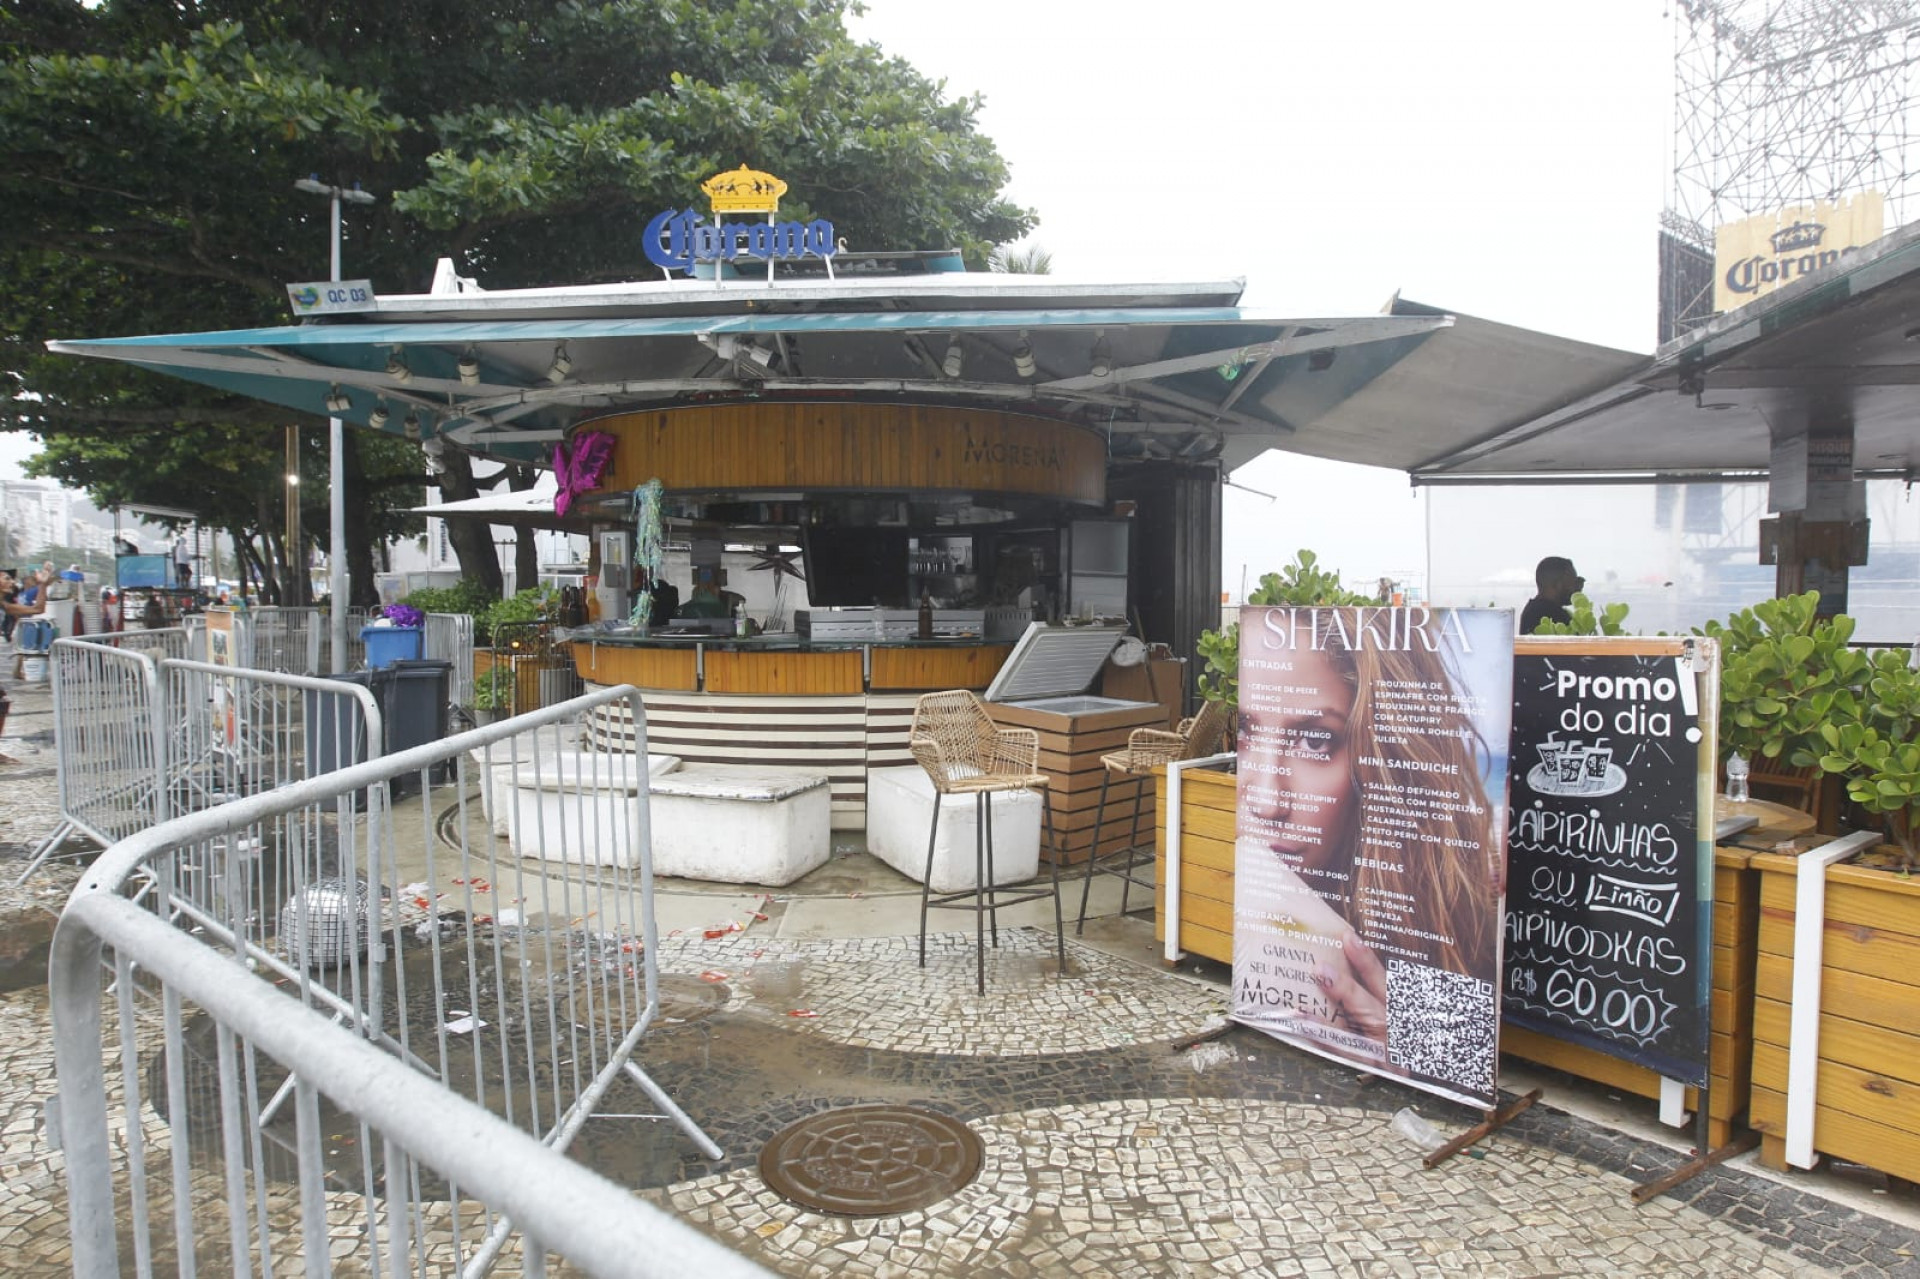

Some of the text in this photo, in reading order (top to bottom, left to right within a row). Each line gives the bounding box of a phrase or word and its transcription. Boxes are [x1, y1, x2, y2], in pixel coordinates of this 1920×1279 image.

[642, 207, 837, 276] Corona
[1726, 246, 1858, 294] Coron
[350, 288, 366, 302] 03
[963, 434, 1061, 470] MORENA
[1264, 607, 1472, 653] SHAKIRA
[1242, 659, 1293, 671] ENTRADAS
[1283, 685, 1294, 693] DE
[1376, 680, 1442, 690] TROUXINHA DE
[1558, 670, 1676, 702] Promo
[1375, 690, 1423, 700] ESPINAFRE
[1426, 693, 1447, 702] COM
[1283, 706, 1294, 715] DE
[1375, 702, 1427, 712] TROUXINHA
[1429, 704, 1442, 712] DE
[1374, 713, 1441, 725] COM CATUPIRY
[1560, 702, 1671, 737] do dia
[1300, 730, 1332, 740] FRANGO
[1374, 723, 1425, 735] TROUXINHA
[1373, 735, 1409, 745] JULIETA
[1296, 750, 1331, 761] TAPIOCA
[1358, 755, 1383, 767] MINI
[1241, 760, 1292, 776] SALGADOS
[1280, 790, 1297, 799] COM
[1298, 792, 1337, 804] CATUPIRY
[1368, 793, 1403, 804] FRANGO
[1405, 798, 1426, 807] COM
[1406, 786, 1460, 800] DEFUMADO
[1291, 802, 1320, 812] QUEIJO
[1367, 804, 1453, 822] AUSTRALIANO COM
[1284, 822, 1295, 830] DE
[1296, 824, 1323, 834] CARNE
[1367, 815, 1418, 829] CALABRESA
[1281, 832, 1322, 845] CROCANTE
[1366, 826, 1480, 850] PEITO PERU COM QUEIJO
[1366, 837, 1403, 850] BRANCO
[1302, 866, 1324, 876] ALHO
[1354, 856, 1404, 873] BEBIDAS
[1531, 866, 1575, 897] OU
[1363, 886, 1415, 902] CAIPIRINHA
[1363, 897, 1380, 907] GIN
[1363, 908, 1403, 922] CERVEJA
[1288, 930, 1343, 949] PRIVATIVO
[1364, 918, 1455, 948] (BRAHMA/ORIGINAL)
[1503, 910, 1686, 975] AIPIVODKAS
[1263, 943, 1316, 965] GARANTA
[1363, 940, 1429, 961] REFRIGERANTE
[1250, 960, 1334, 989] SEU INGRESSO
[1511, 967, 1537, 996] R$
[1241, 977, 1347, 1023] MORENA
